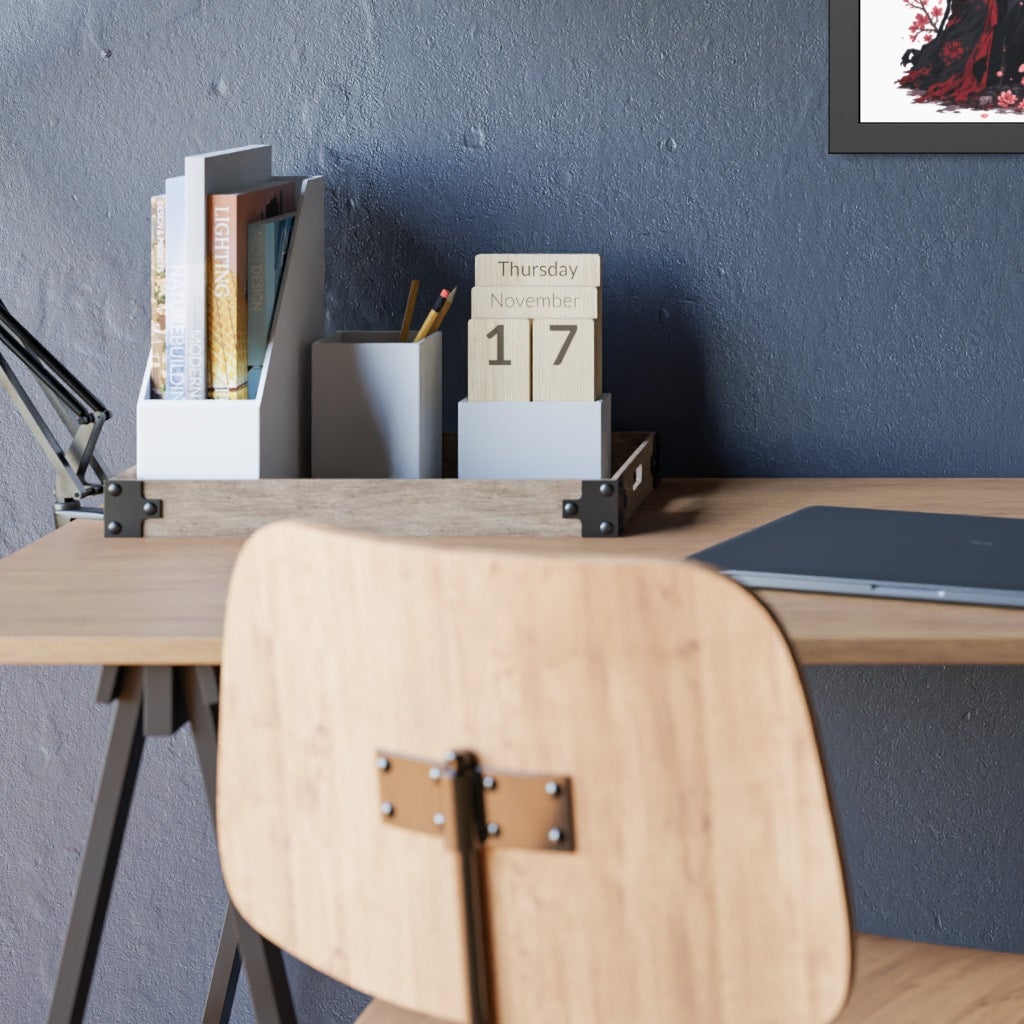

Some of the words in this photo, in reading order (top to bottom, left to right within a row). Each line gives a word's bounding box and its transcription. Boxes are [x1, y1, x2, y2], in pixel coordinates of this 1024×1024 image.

[214, 206, 230, 298] LIGHTING
[498, 261, 579, 280] Thursday
[251, 265, 263, 311] DESIGN
[490, 293, 581, 309] November
[188, 329, 203, 398] MODERN
